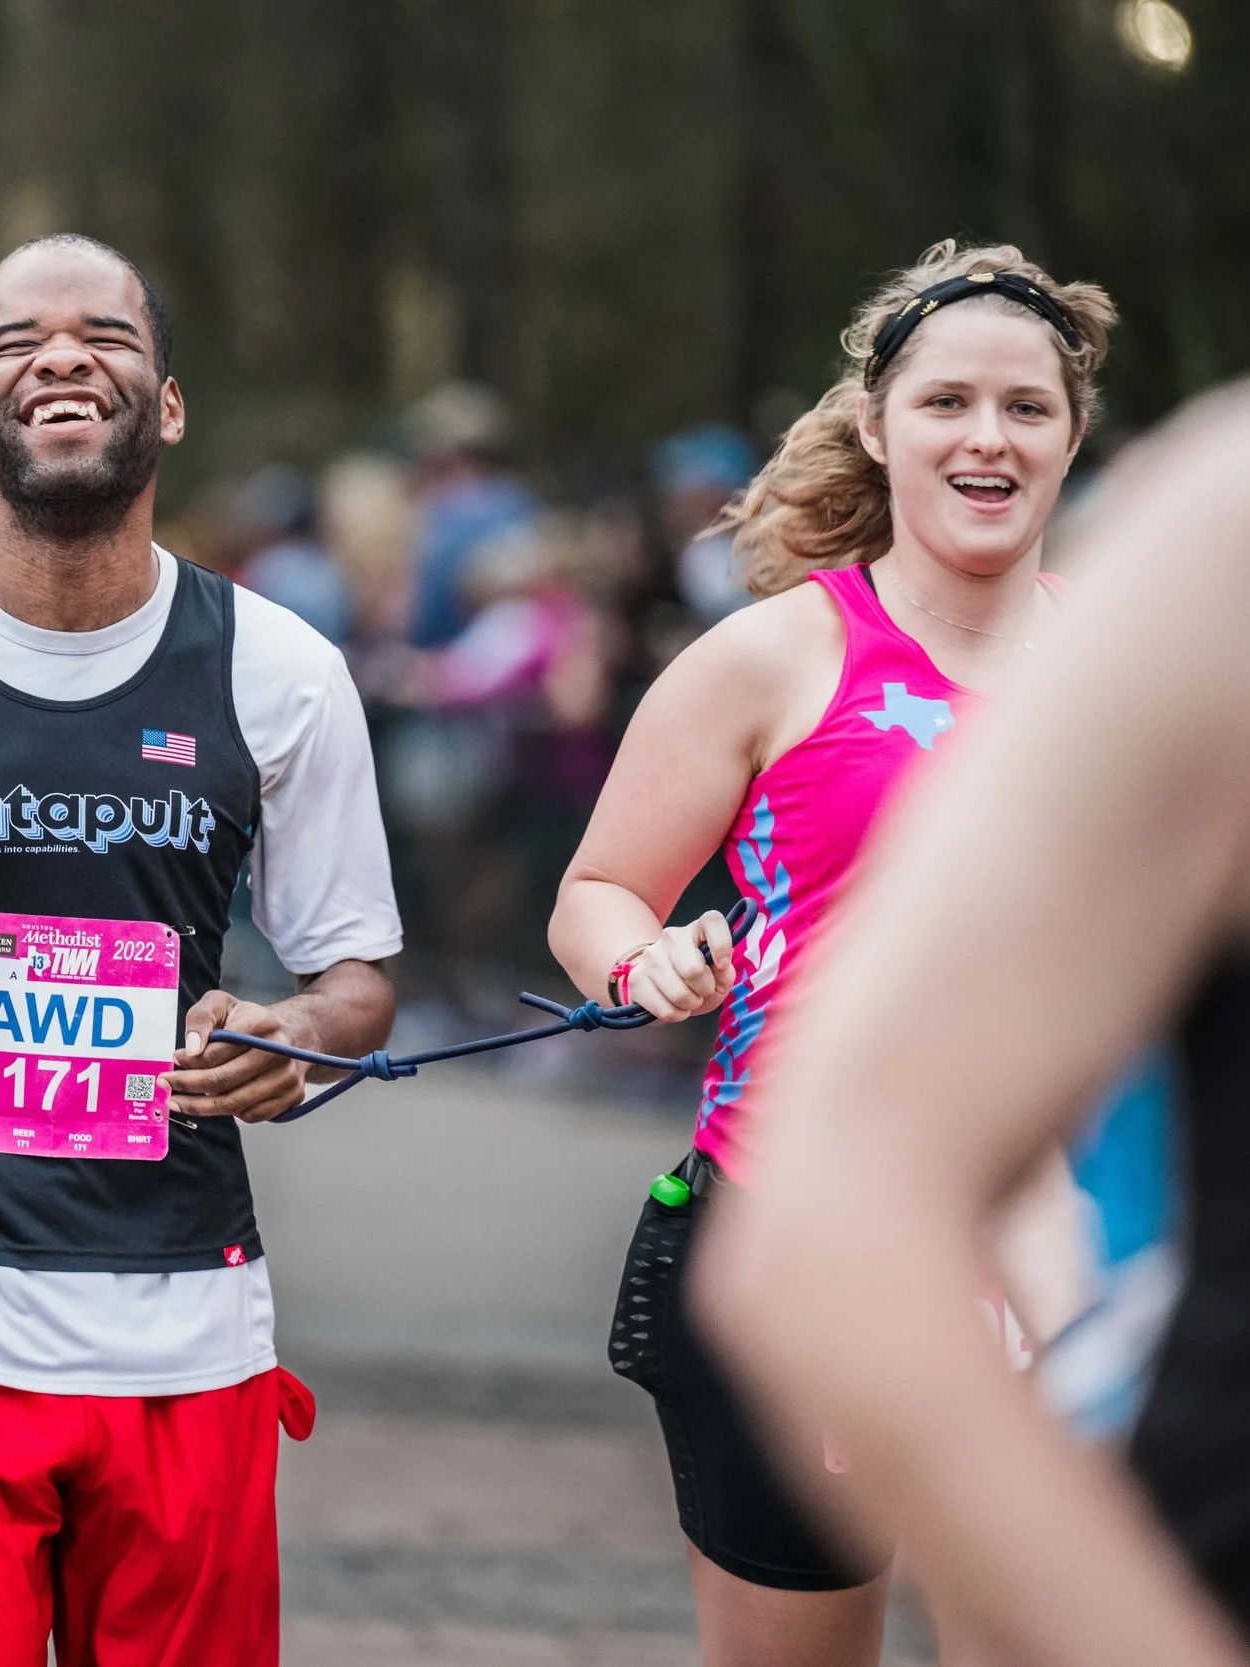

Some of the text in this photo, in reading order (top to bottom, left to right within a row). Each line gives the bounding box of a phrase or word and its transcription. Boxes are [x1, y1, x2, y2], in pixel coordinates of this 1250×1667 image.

[4, 845, 23, 853] into
[25, 845, 81, 854] capabilities.
[21, 924, 54, 932] HOUSTON
[21, 929, 101, 948] Methodist
[112, 940, 156, 961] 2022
[50, 947, 100, 976] TWM
[9, 971, 18, 980] A
[3, 1057, 101, 1113] 171
[13, 1128, 35, 1138] BEER
[68, 1133, 92, 1142] FOOD
[127, 1135, 152, 1143] SHIRT
[16, 1140, 30, 1148] 171
[73, 1143, 87, 1151] 171
